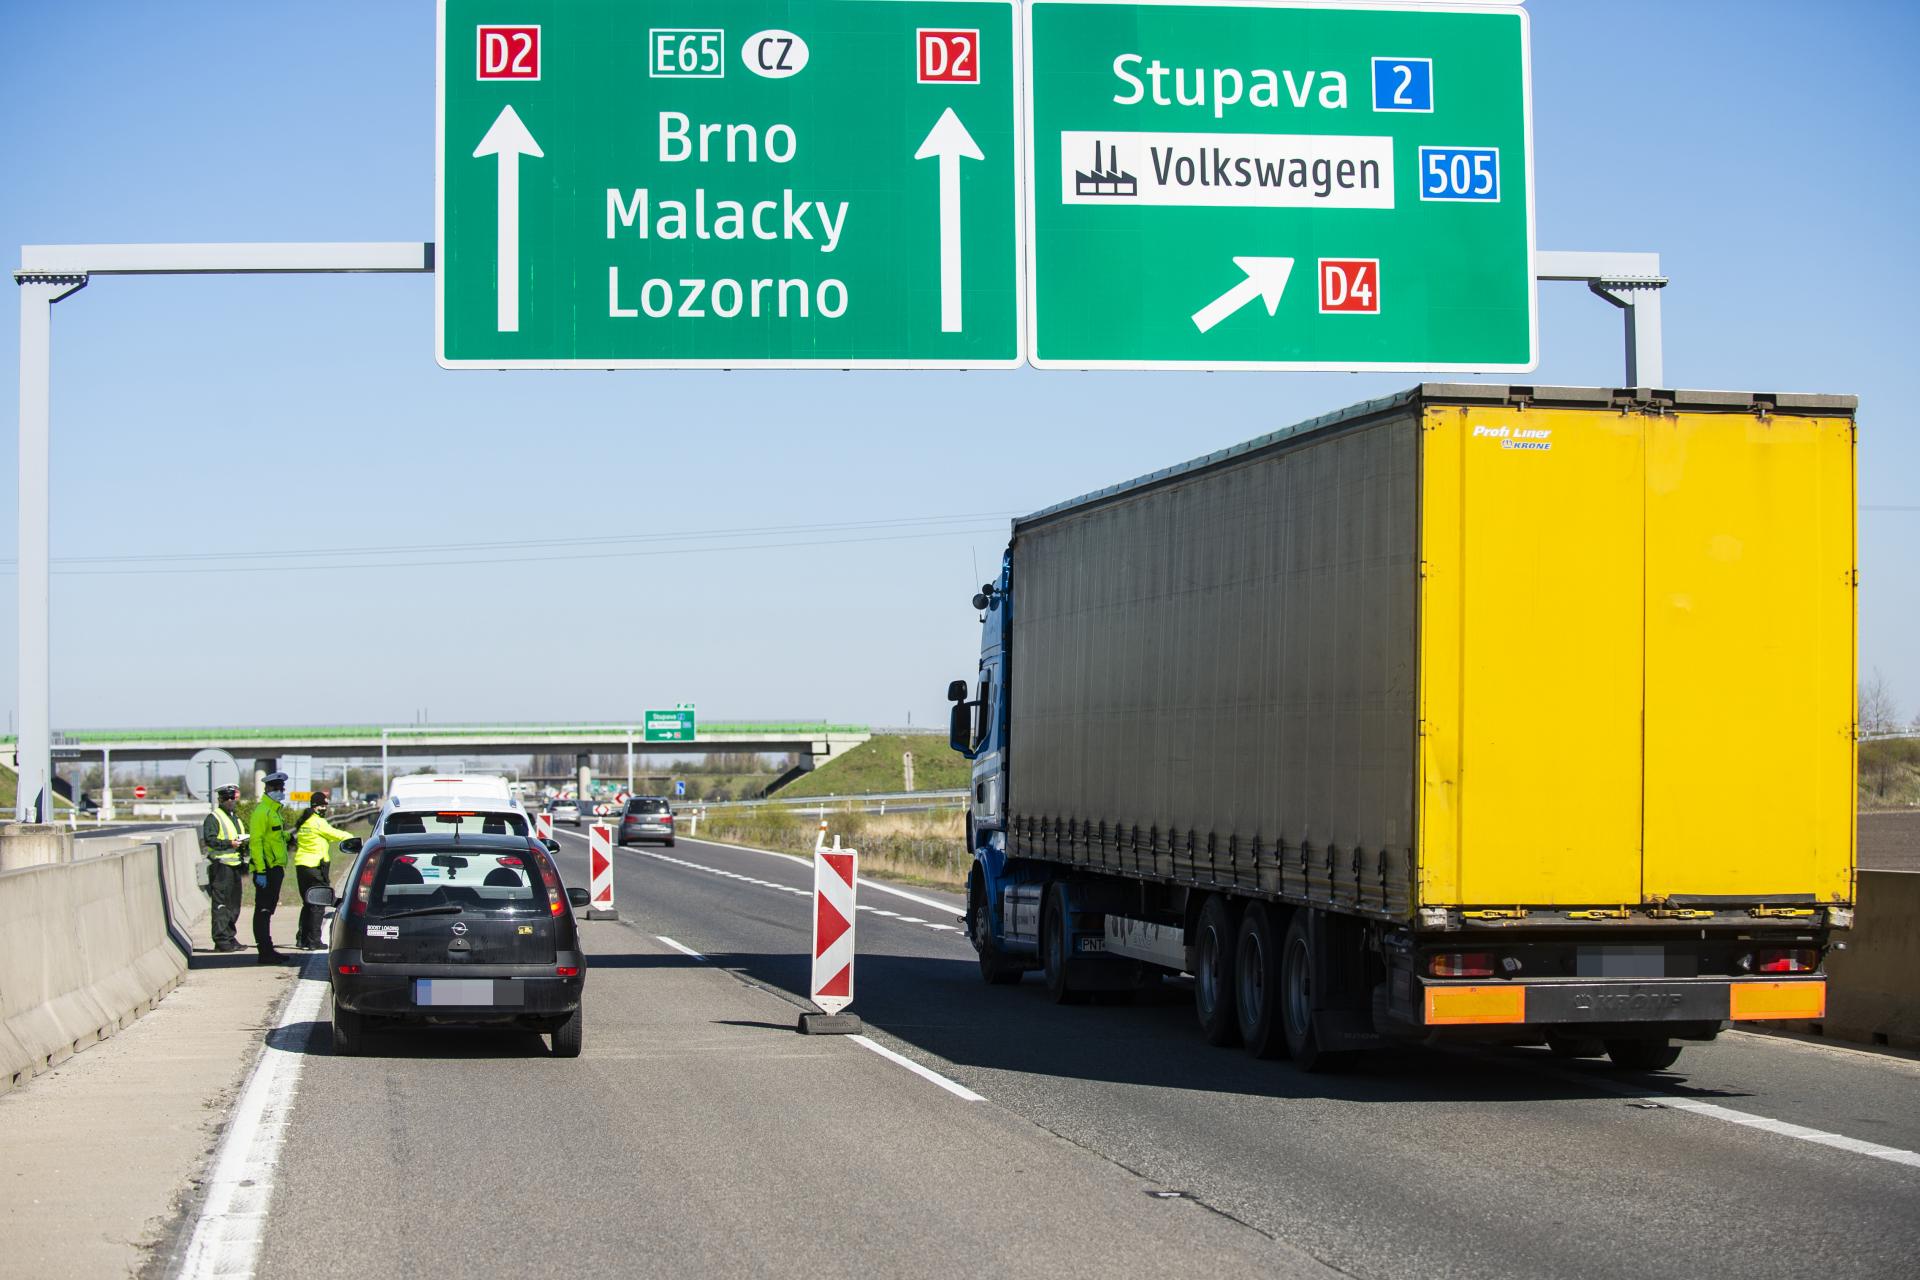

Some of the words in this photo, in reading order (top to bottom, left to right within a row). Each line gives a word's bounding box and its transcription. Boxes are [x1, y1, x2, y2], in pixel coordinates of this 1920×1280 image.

[485, 33, 532, 73] D2
[657, 35, 719, 72] E65
[757, 38, 793, 71] CZ
[925, 37, 971, 77] D2
[1112, 53, 1348, 118] Stupava
[1393, 65, 1413, 105] 2
[659, 112, 797, 163] Brno
[1151, 147, 1380, 198] Volkswagen
[1428, 154, 1493, 195] 505
[607, 189, 849, 252] Malacky
[609, 267, 849, 319] Lozorno
[1325, 266, 1373, 307] D4
[1513, 428, 1551, 439] Liner
[1514, 442, 1551, 450] KRONE
[1597, 993, 1683, 1009] KRONE
